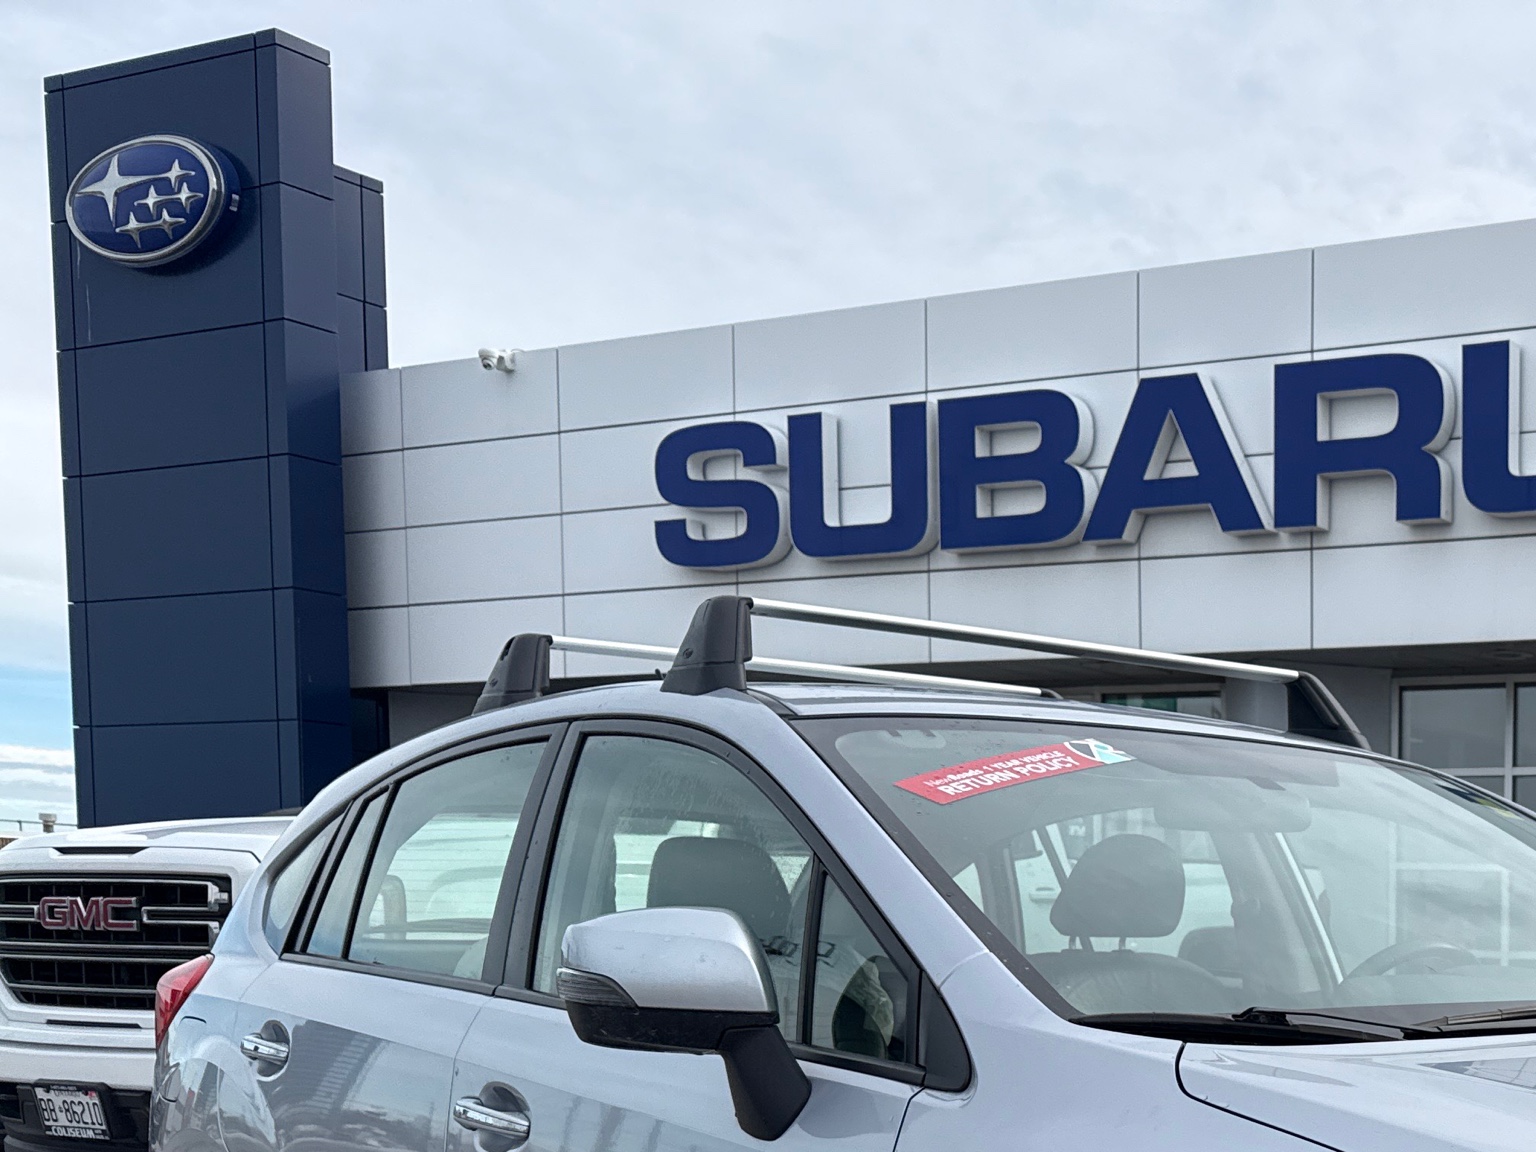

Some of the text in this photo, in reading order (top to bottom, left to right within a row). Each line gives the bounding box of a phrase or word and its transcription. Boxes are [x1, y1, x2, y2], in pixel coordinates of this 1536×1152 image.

[990, 759, 1023, 770] YEAR
[1019, 750, 1065, 763] VEHICLE
[937, 755, 1080, 796] RETURN POLICY
[38, 896, 139, 931] GMC
[51, 1126, 96, 1139] COLISEUM
